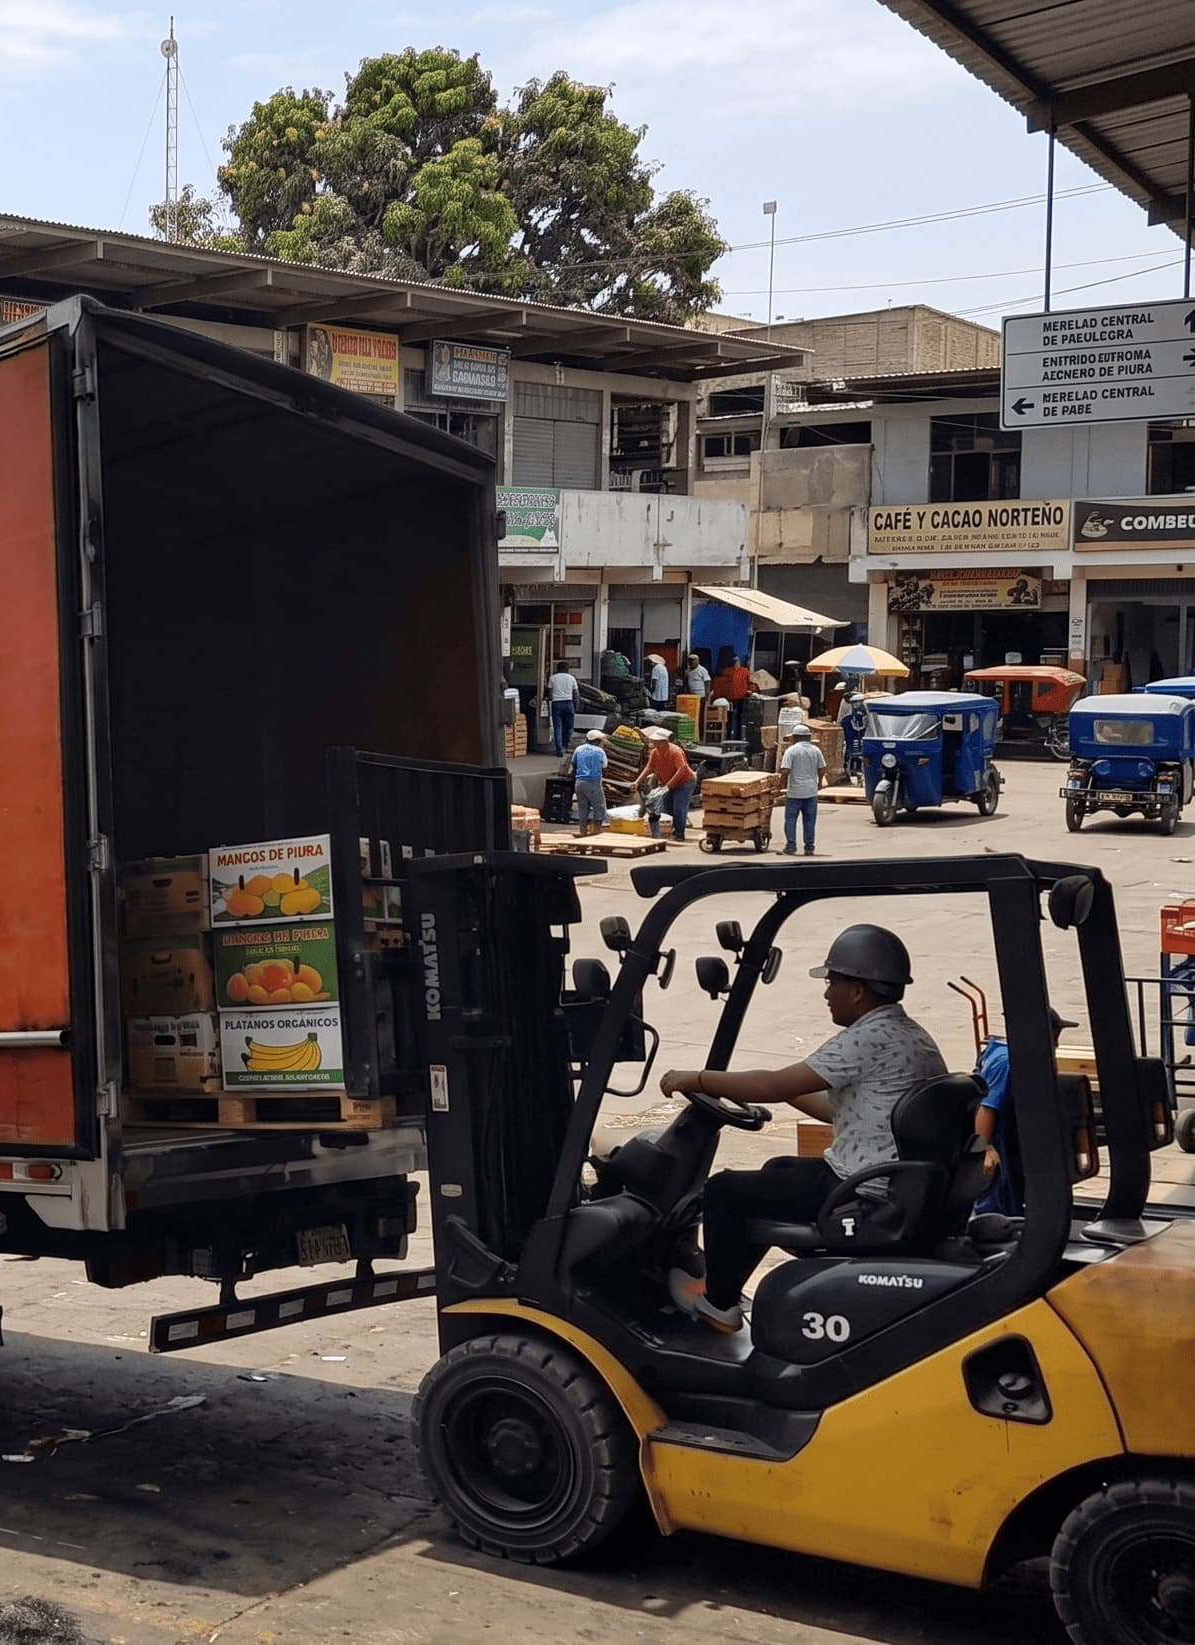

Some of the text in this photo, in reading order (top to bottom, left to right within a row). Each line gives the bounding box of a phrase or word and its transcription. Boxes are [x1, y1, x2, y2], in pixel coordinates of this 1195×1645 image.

[1043, 313, 1155, 333] MERELAD CENTRAL
[1043, 335, 1058, 347] DE
[1099, 366, 1114, 377] DE
[1117, 363, 1153, 375] PIURA
[1043, 386, 1155, 403] MERELAD CENTRAL
[1043, 406, 1058, 417] DE
[874, 503, 1064, 531] CAFÉ Y CACAO NORTEÑO
[269, 848, 284, 861] DE
[287, 844, 323, 859] PIURA
[418, 912, 442, 1021] KOMATSU
[858, 1274, 923, 1289] KOMATSU
[801, 1312, 851, 1342] 30
